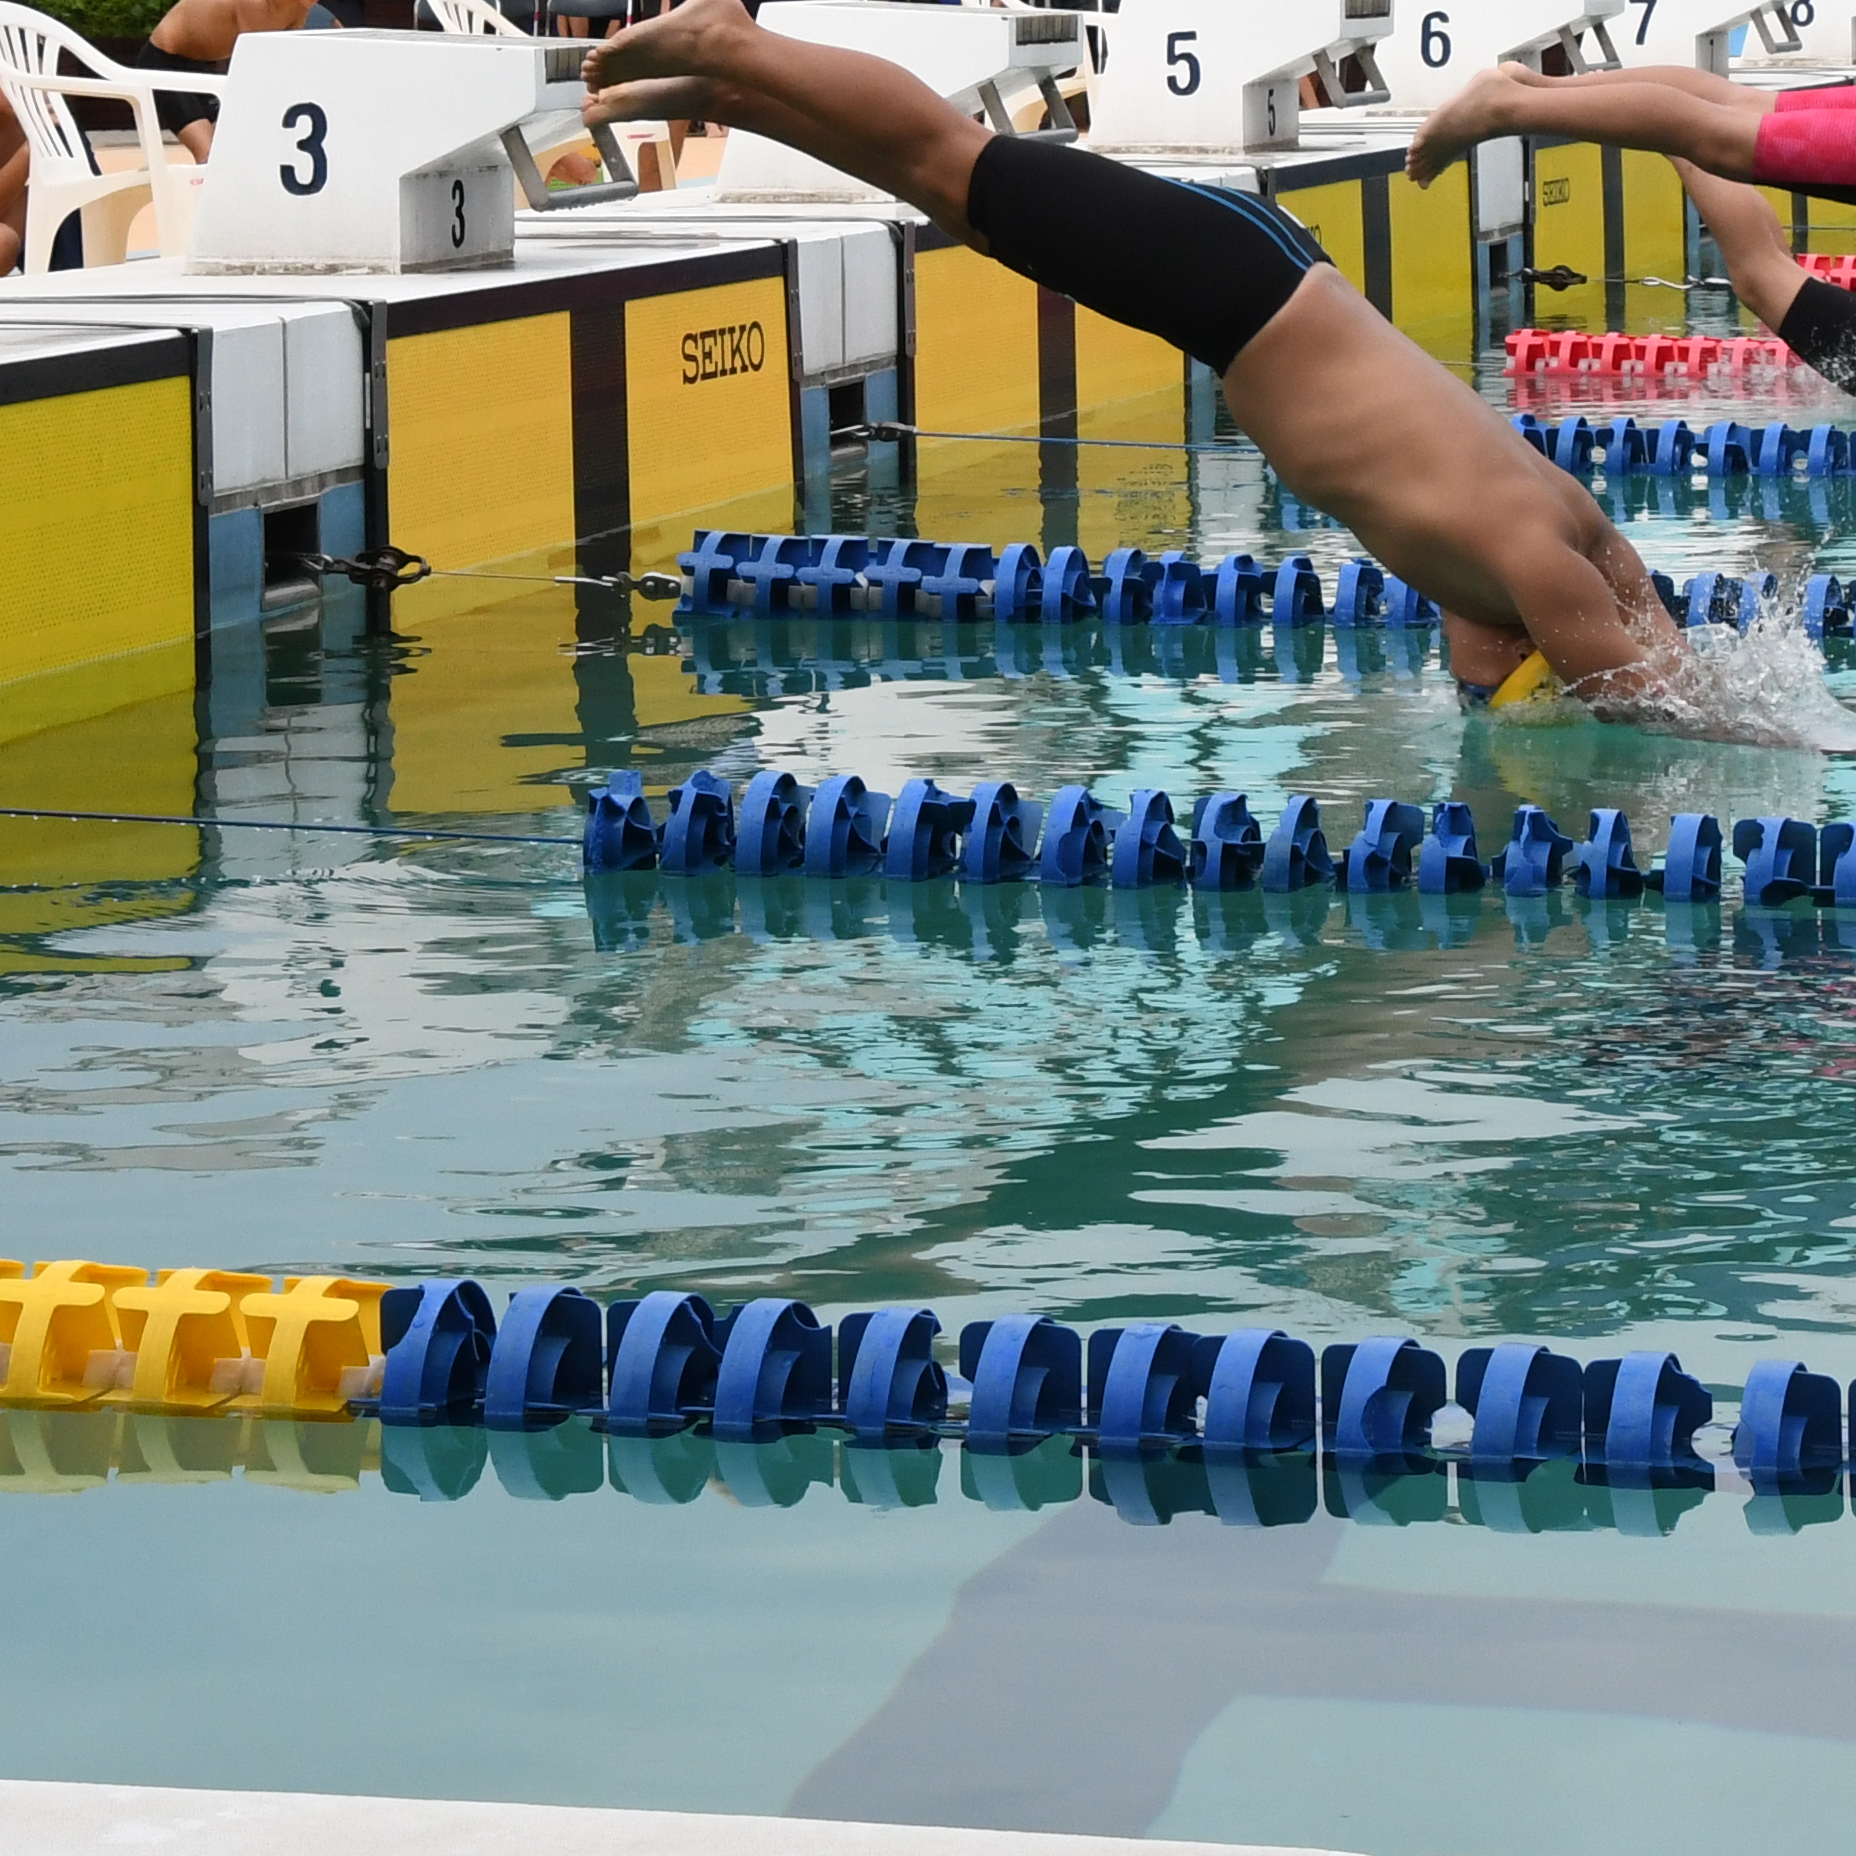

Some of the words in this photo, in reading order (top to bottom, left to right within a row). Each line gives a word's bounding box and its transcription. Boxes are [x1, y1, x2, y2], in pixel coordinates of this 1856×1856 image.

[1167, 31, 1201, 96] 5
[1421, 11, 1451, 68] 6
[1268, 88, 1276, 136] 5
[280, 102, 328, 196] 3
[450, 179, 466, 249] 3
[681, 320, 765, 385] SEIKO
